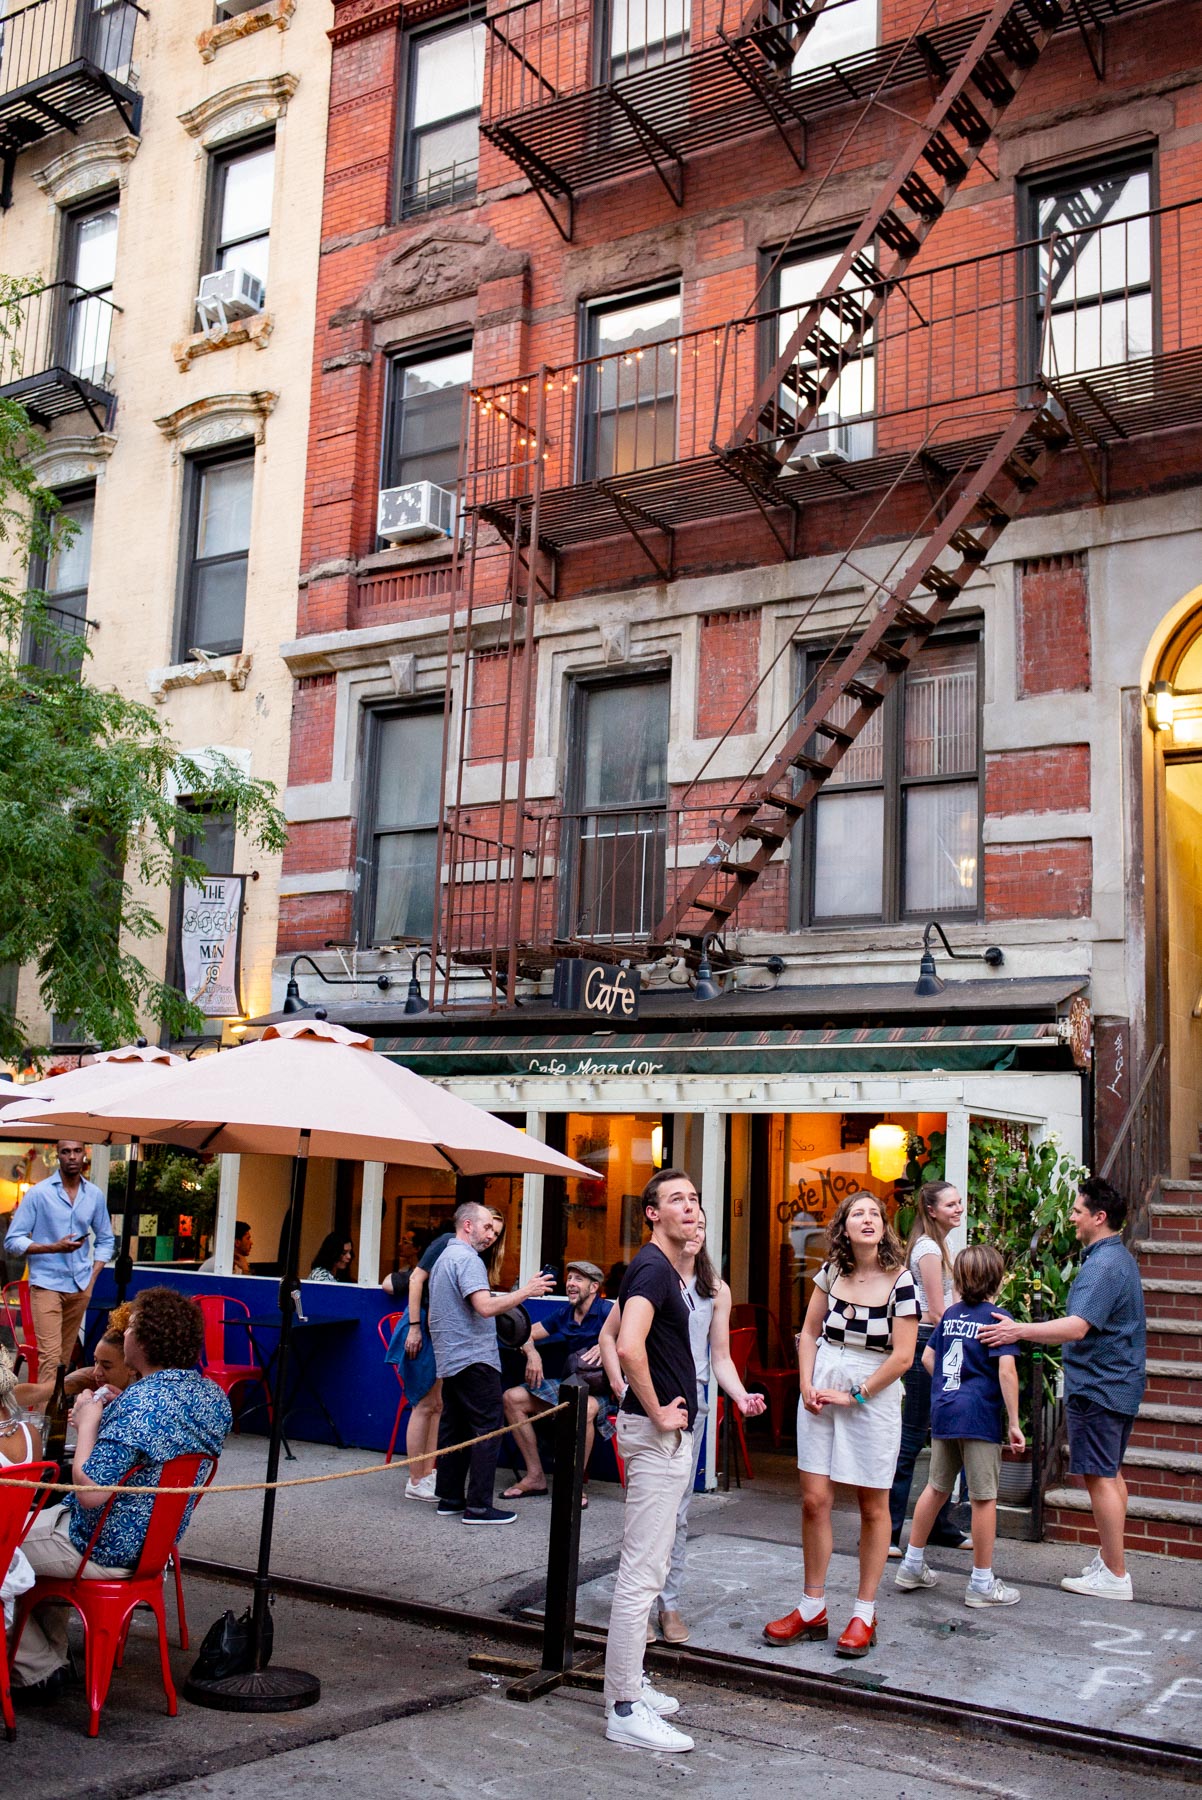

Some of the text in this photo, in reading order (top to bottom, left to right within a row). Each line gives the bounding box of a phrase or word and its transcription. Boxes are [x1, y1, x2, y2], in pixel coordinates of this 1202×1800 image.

[202, 885, 225, 900] THE
[200, 945, 225, 959] MAN
[585, 966, 635, 1015] Cafe
[528, 1058, 567, 1076] Cafe
[776, 1178, 821, 1224] Cafe
[942, 1338, 964, 1392] 4
